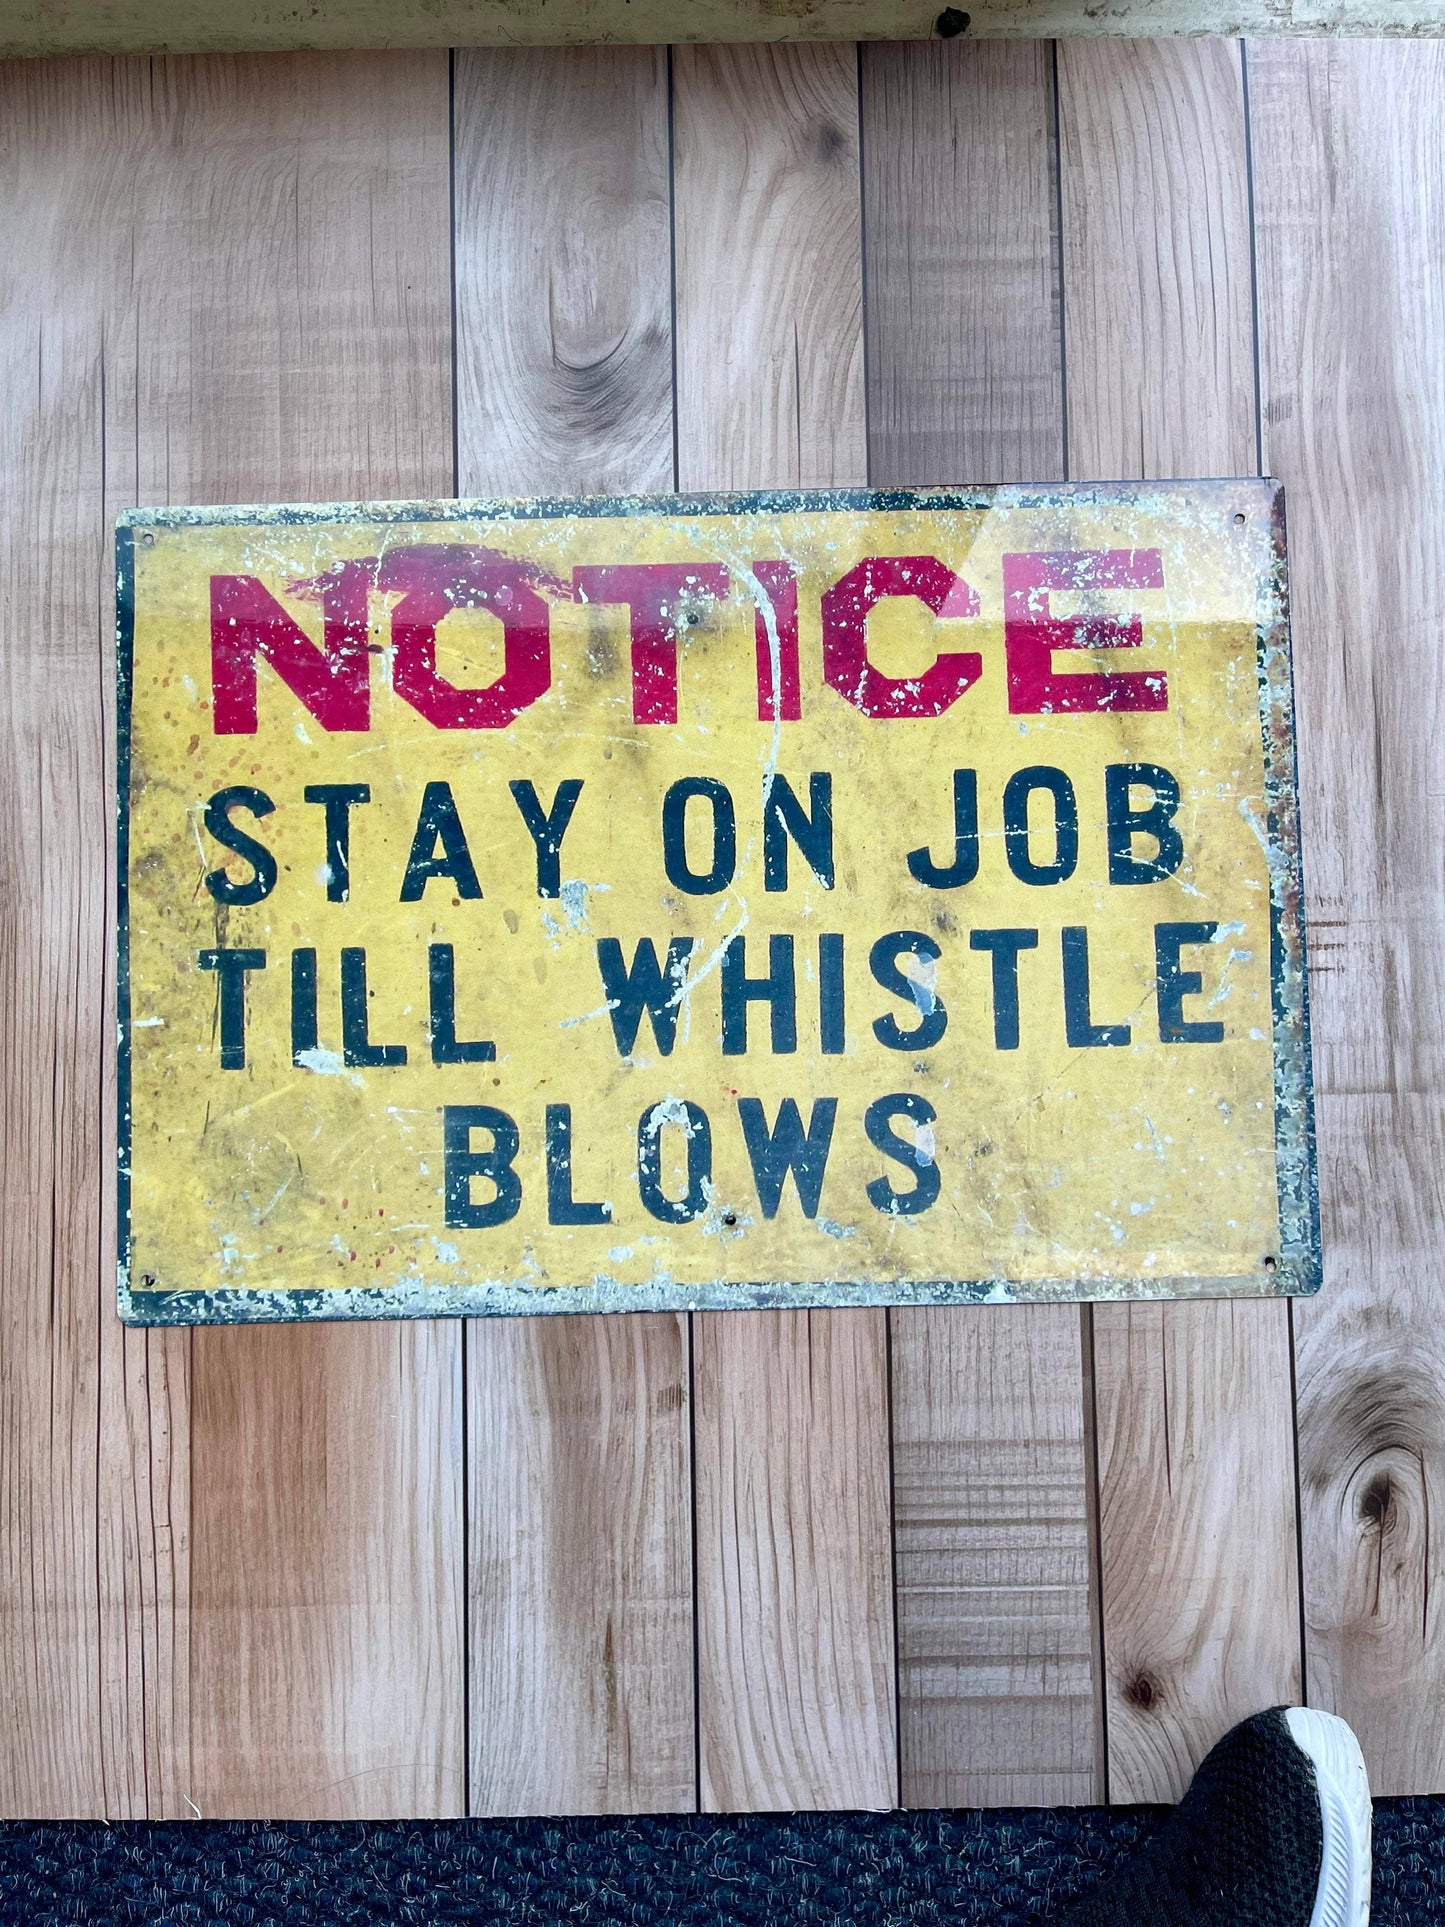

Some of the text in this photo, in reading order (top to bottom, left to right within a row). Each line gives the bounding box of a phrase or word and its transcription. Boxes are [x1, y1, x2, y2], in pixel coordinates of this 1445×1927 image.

[210, 546, 1169, 735] NOTICE
[204, 763, 1185, 906] STAY ON JOB
[199, 922, 1226, 1071] TILL WHISTLE
[444, 1092, 942, 1230] BLOWS
